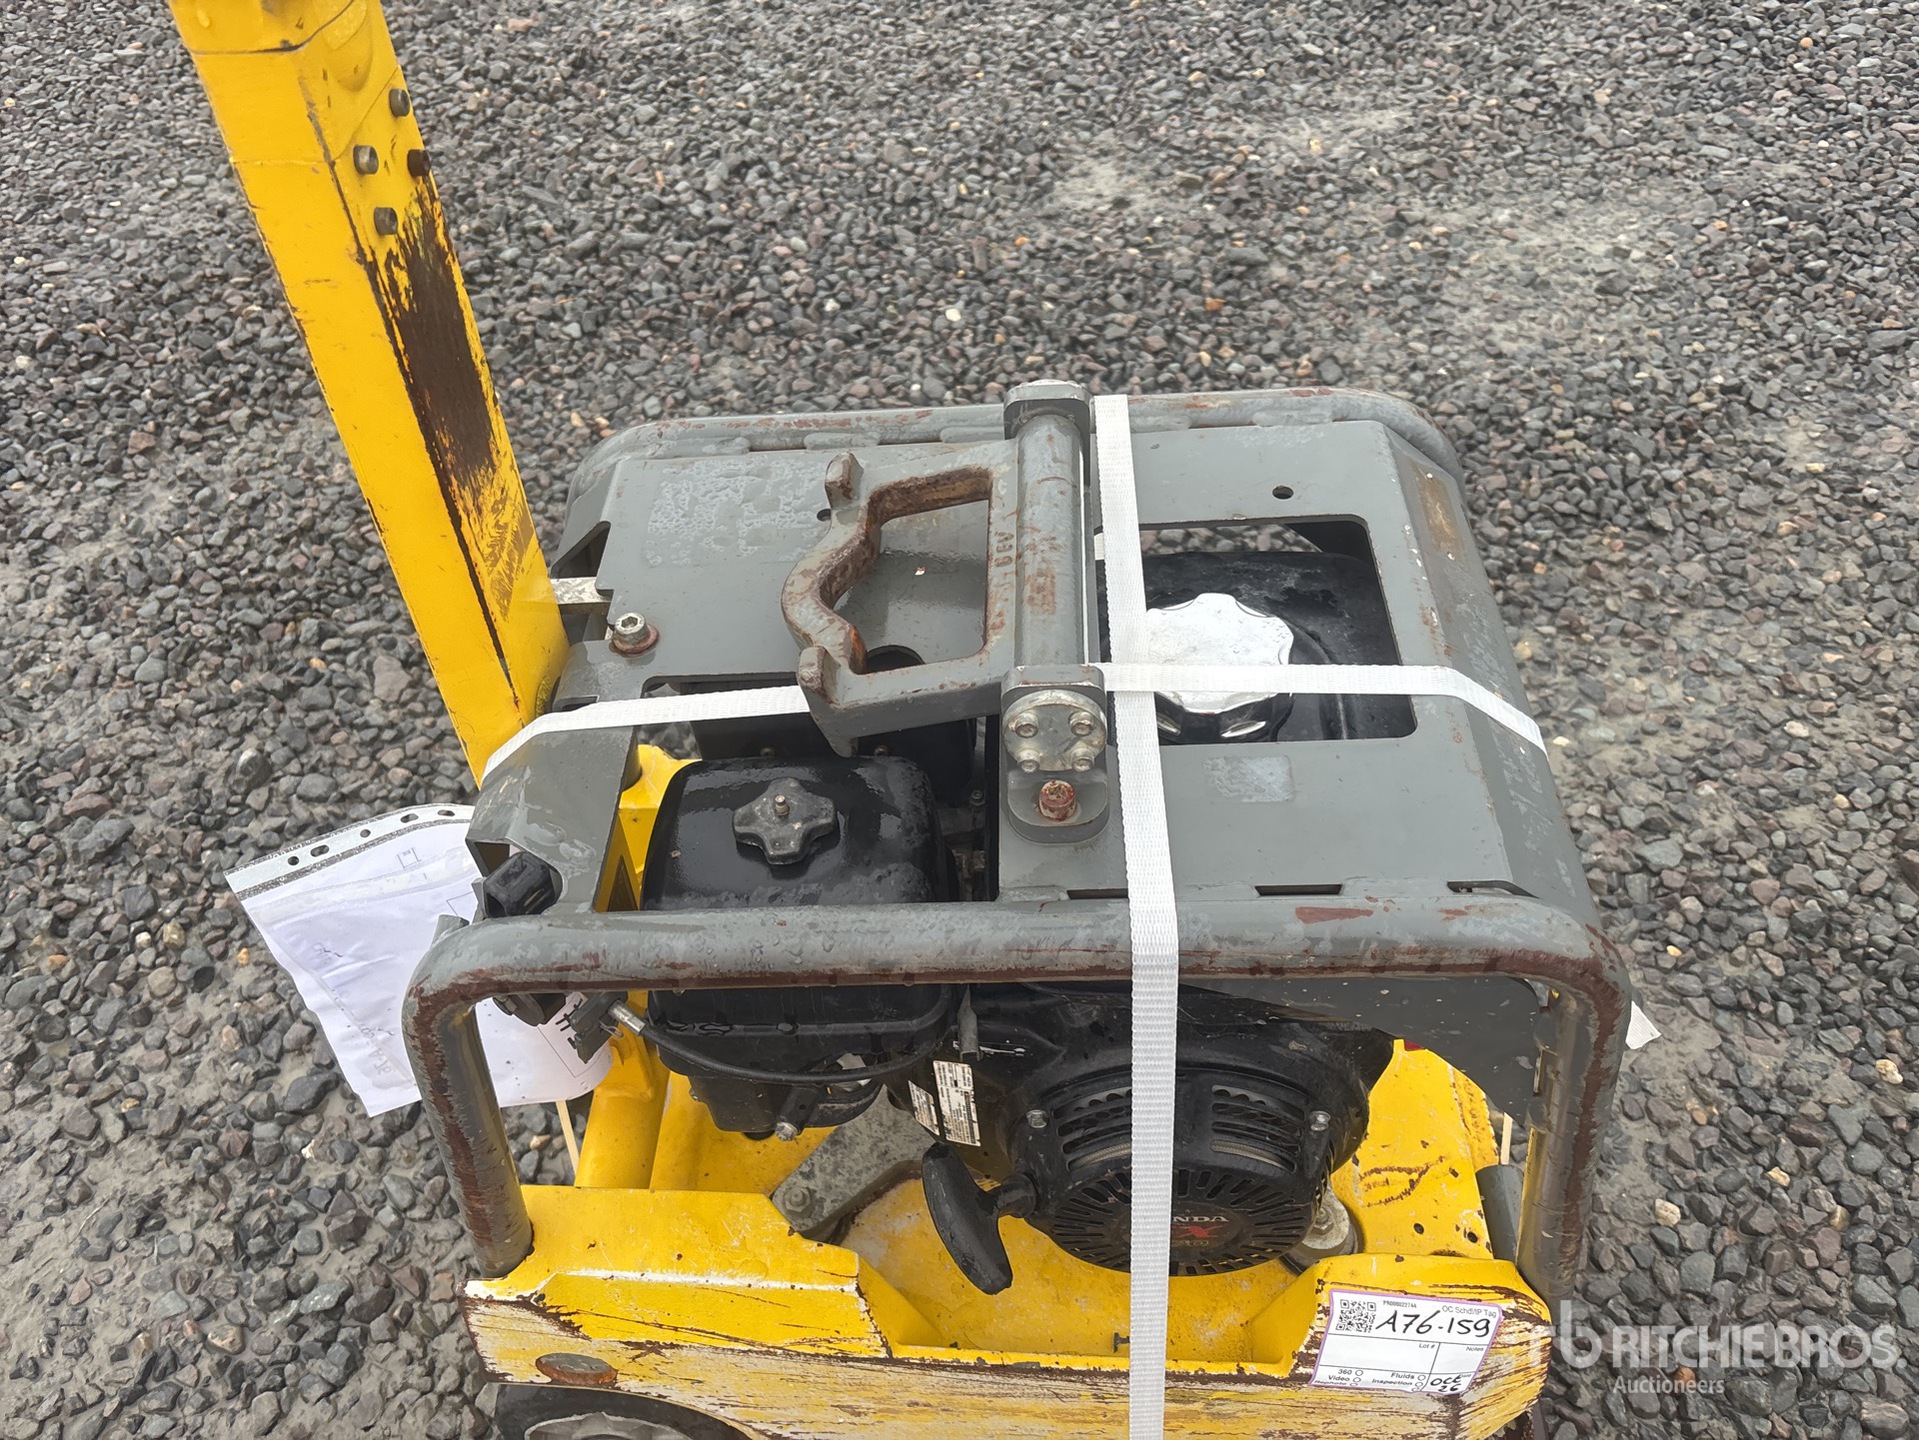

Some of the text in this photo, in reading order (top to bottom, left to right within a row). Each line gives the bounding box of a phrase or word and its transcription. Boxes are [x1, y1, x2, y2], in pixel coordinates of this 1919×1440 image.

[1483, 1309, 1497, 1318] Tag
[1375, 1310, 1490, 1338] A76-159
[1438, 1383, 1462, 1392] 26
